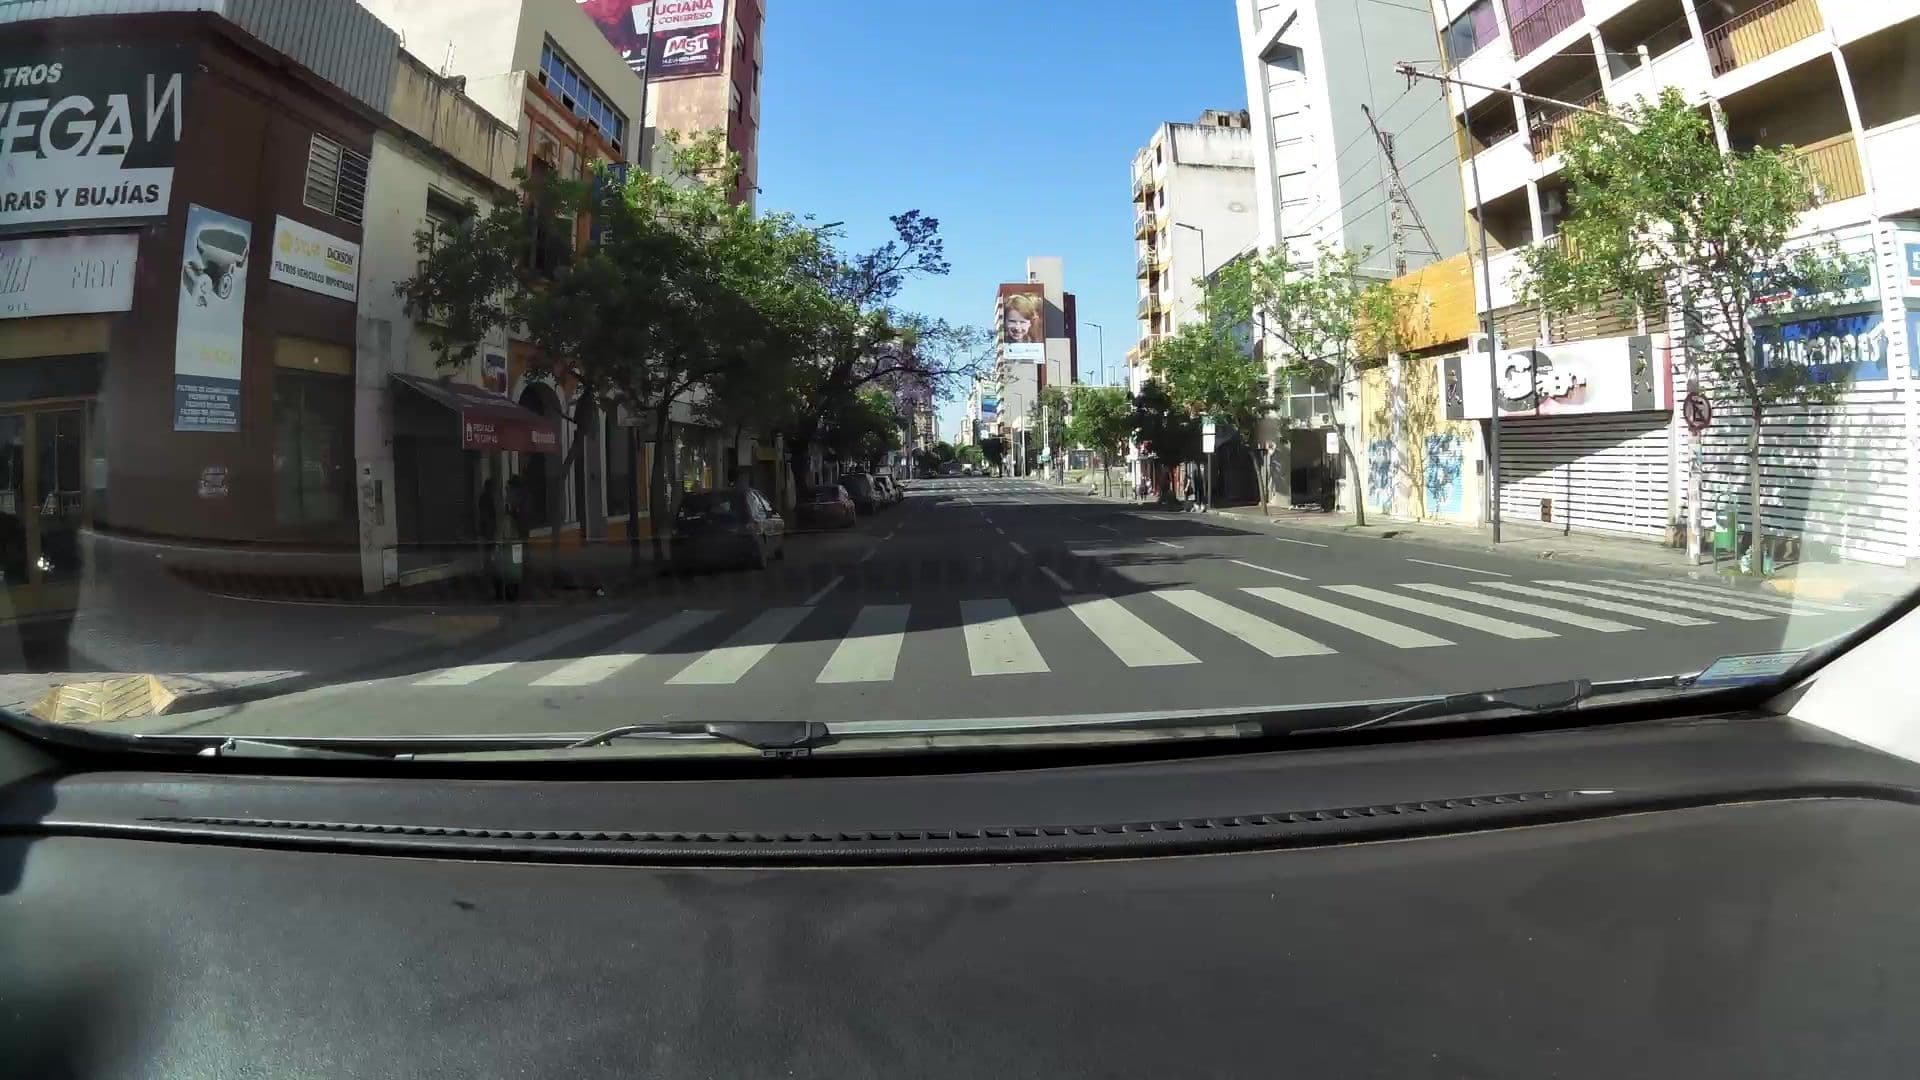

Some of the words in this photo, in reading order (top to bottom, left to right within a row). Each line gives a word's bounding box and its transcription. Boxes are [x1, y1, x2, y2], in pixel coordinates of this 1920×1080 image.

[659, 11, 713, 24] CONGRESO
[668, 36, 705, 53] MST
[0, 63, 63, 88] TROS
[55, 188, 69, 207] Y
[75, 181, 160, 207] BUJÍAS
